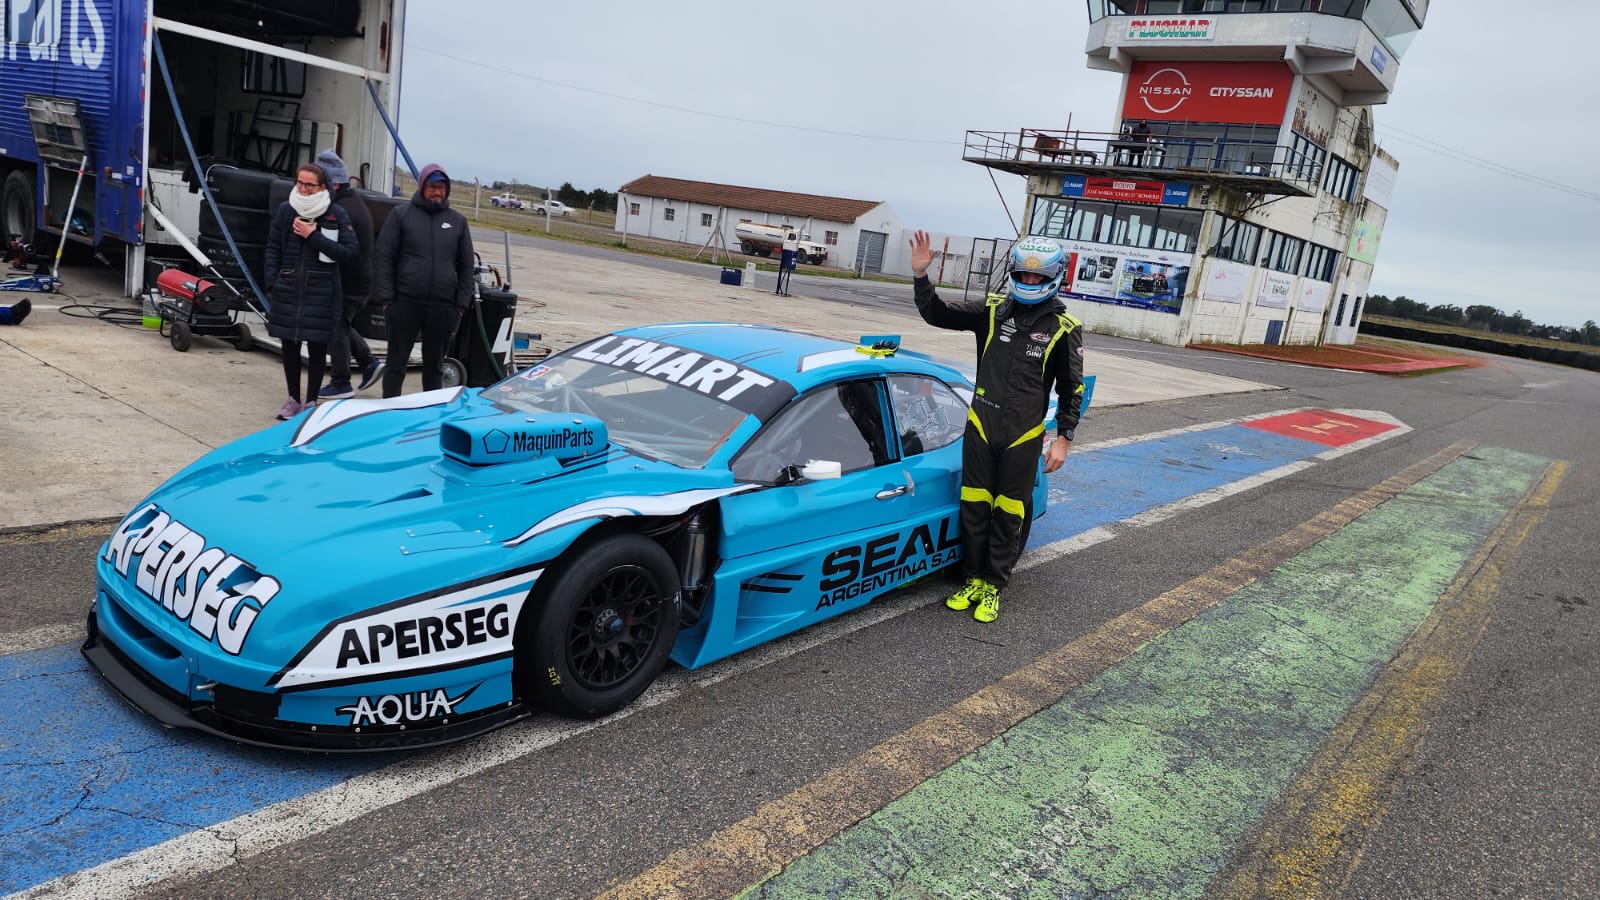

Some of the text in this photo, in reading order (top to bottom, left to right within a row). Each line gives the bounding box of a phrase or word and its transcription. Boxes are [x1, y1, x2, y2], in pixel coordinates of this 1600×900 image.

[1129, 20, 1209, 37] PLUSMAR
[1139, 86, 1192, 96] NISSAN
[1209, 87, 1274, 99] CITYSSAN
[572, 334, 774, 401] LIMART
[513, 427, 594, 456] MaquinParts
[103, 503, 281, 655] APERSEG
[815, 547, 961, 612] ARGENTINA S.A.
[819, 517, 962, 592] SEAL
[336, 602, 511, 669] APERSEG
[352, 689, 452, 725] AQUA
